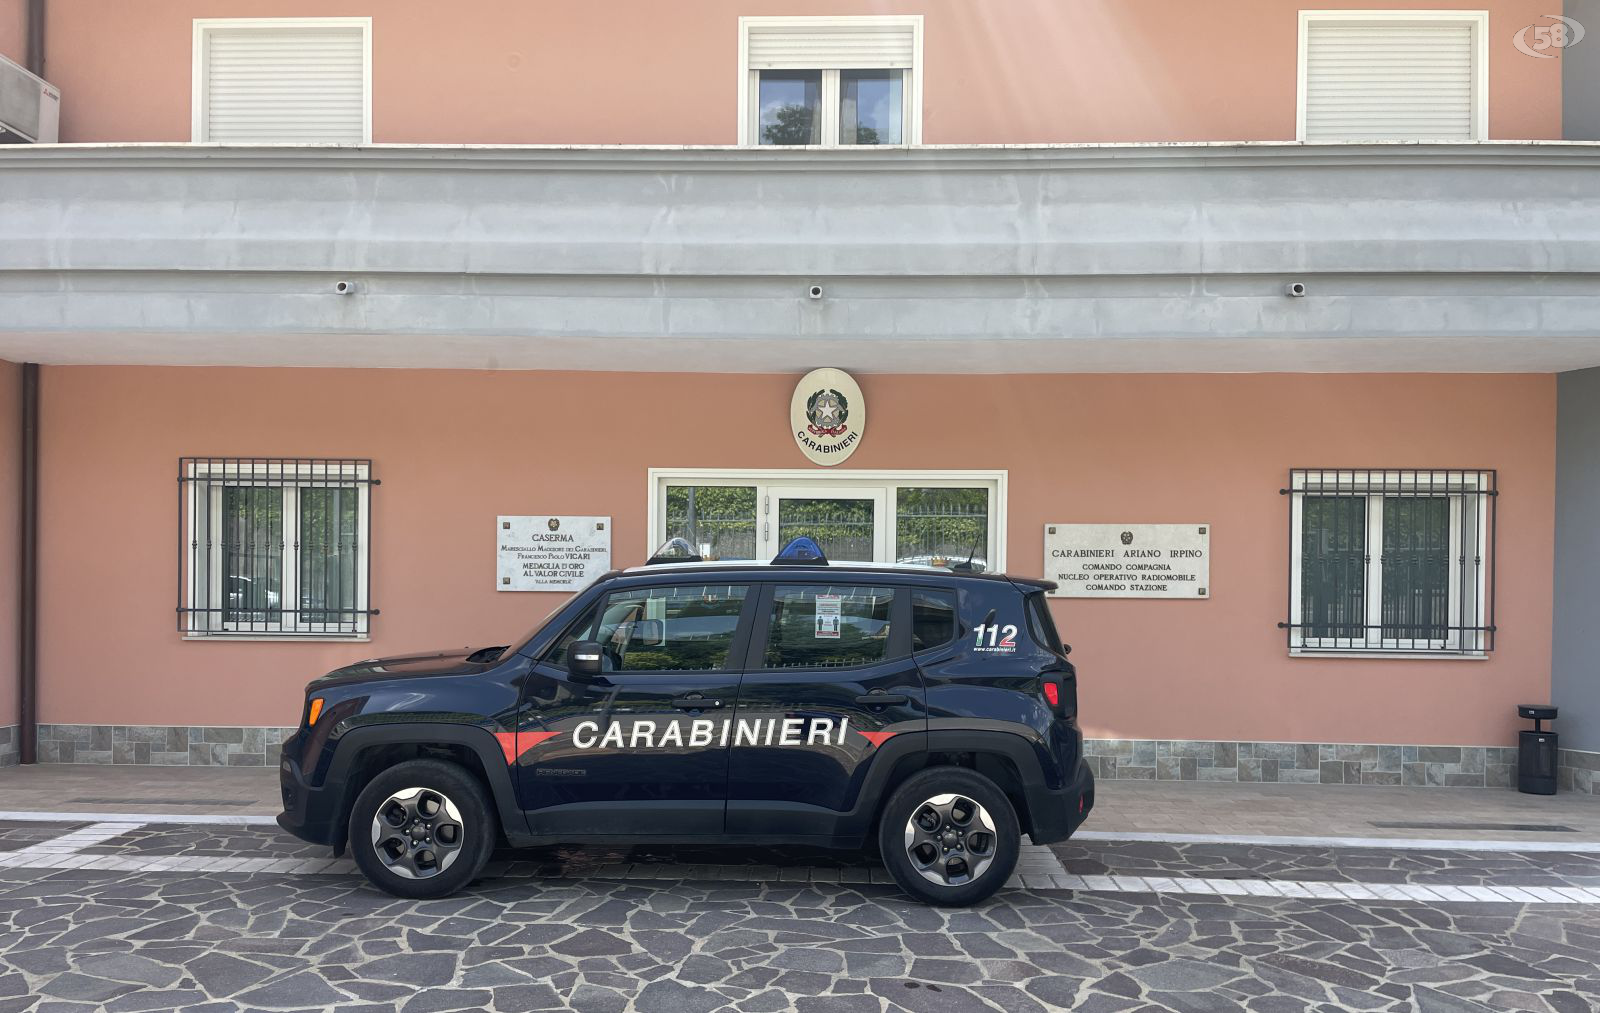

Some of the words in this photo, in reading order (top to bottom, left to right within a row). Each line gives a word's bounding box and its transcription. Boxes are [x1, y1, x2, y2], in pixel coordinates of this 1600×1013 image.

[798, 431, 858, 453] CARABINIERI
[531, 534, 574, 542] CASERMA
[1052, 550, 1114, 558] CARABINIERI
[1123, 550, 1161, 558] ARIANO
[1170, 550, 1203, 558] IRPINO
[974, 624, 1017, 646] 112
[572, 718, 849, 748] CARABINIERI
